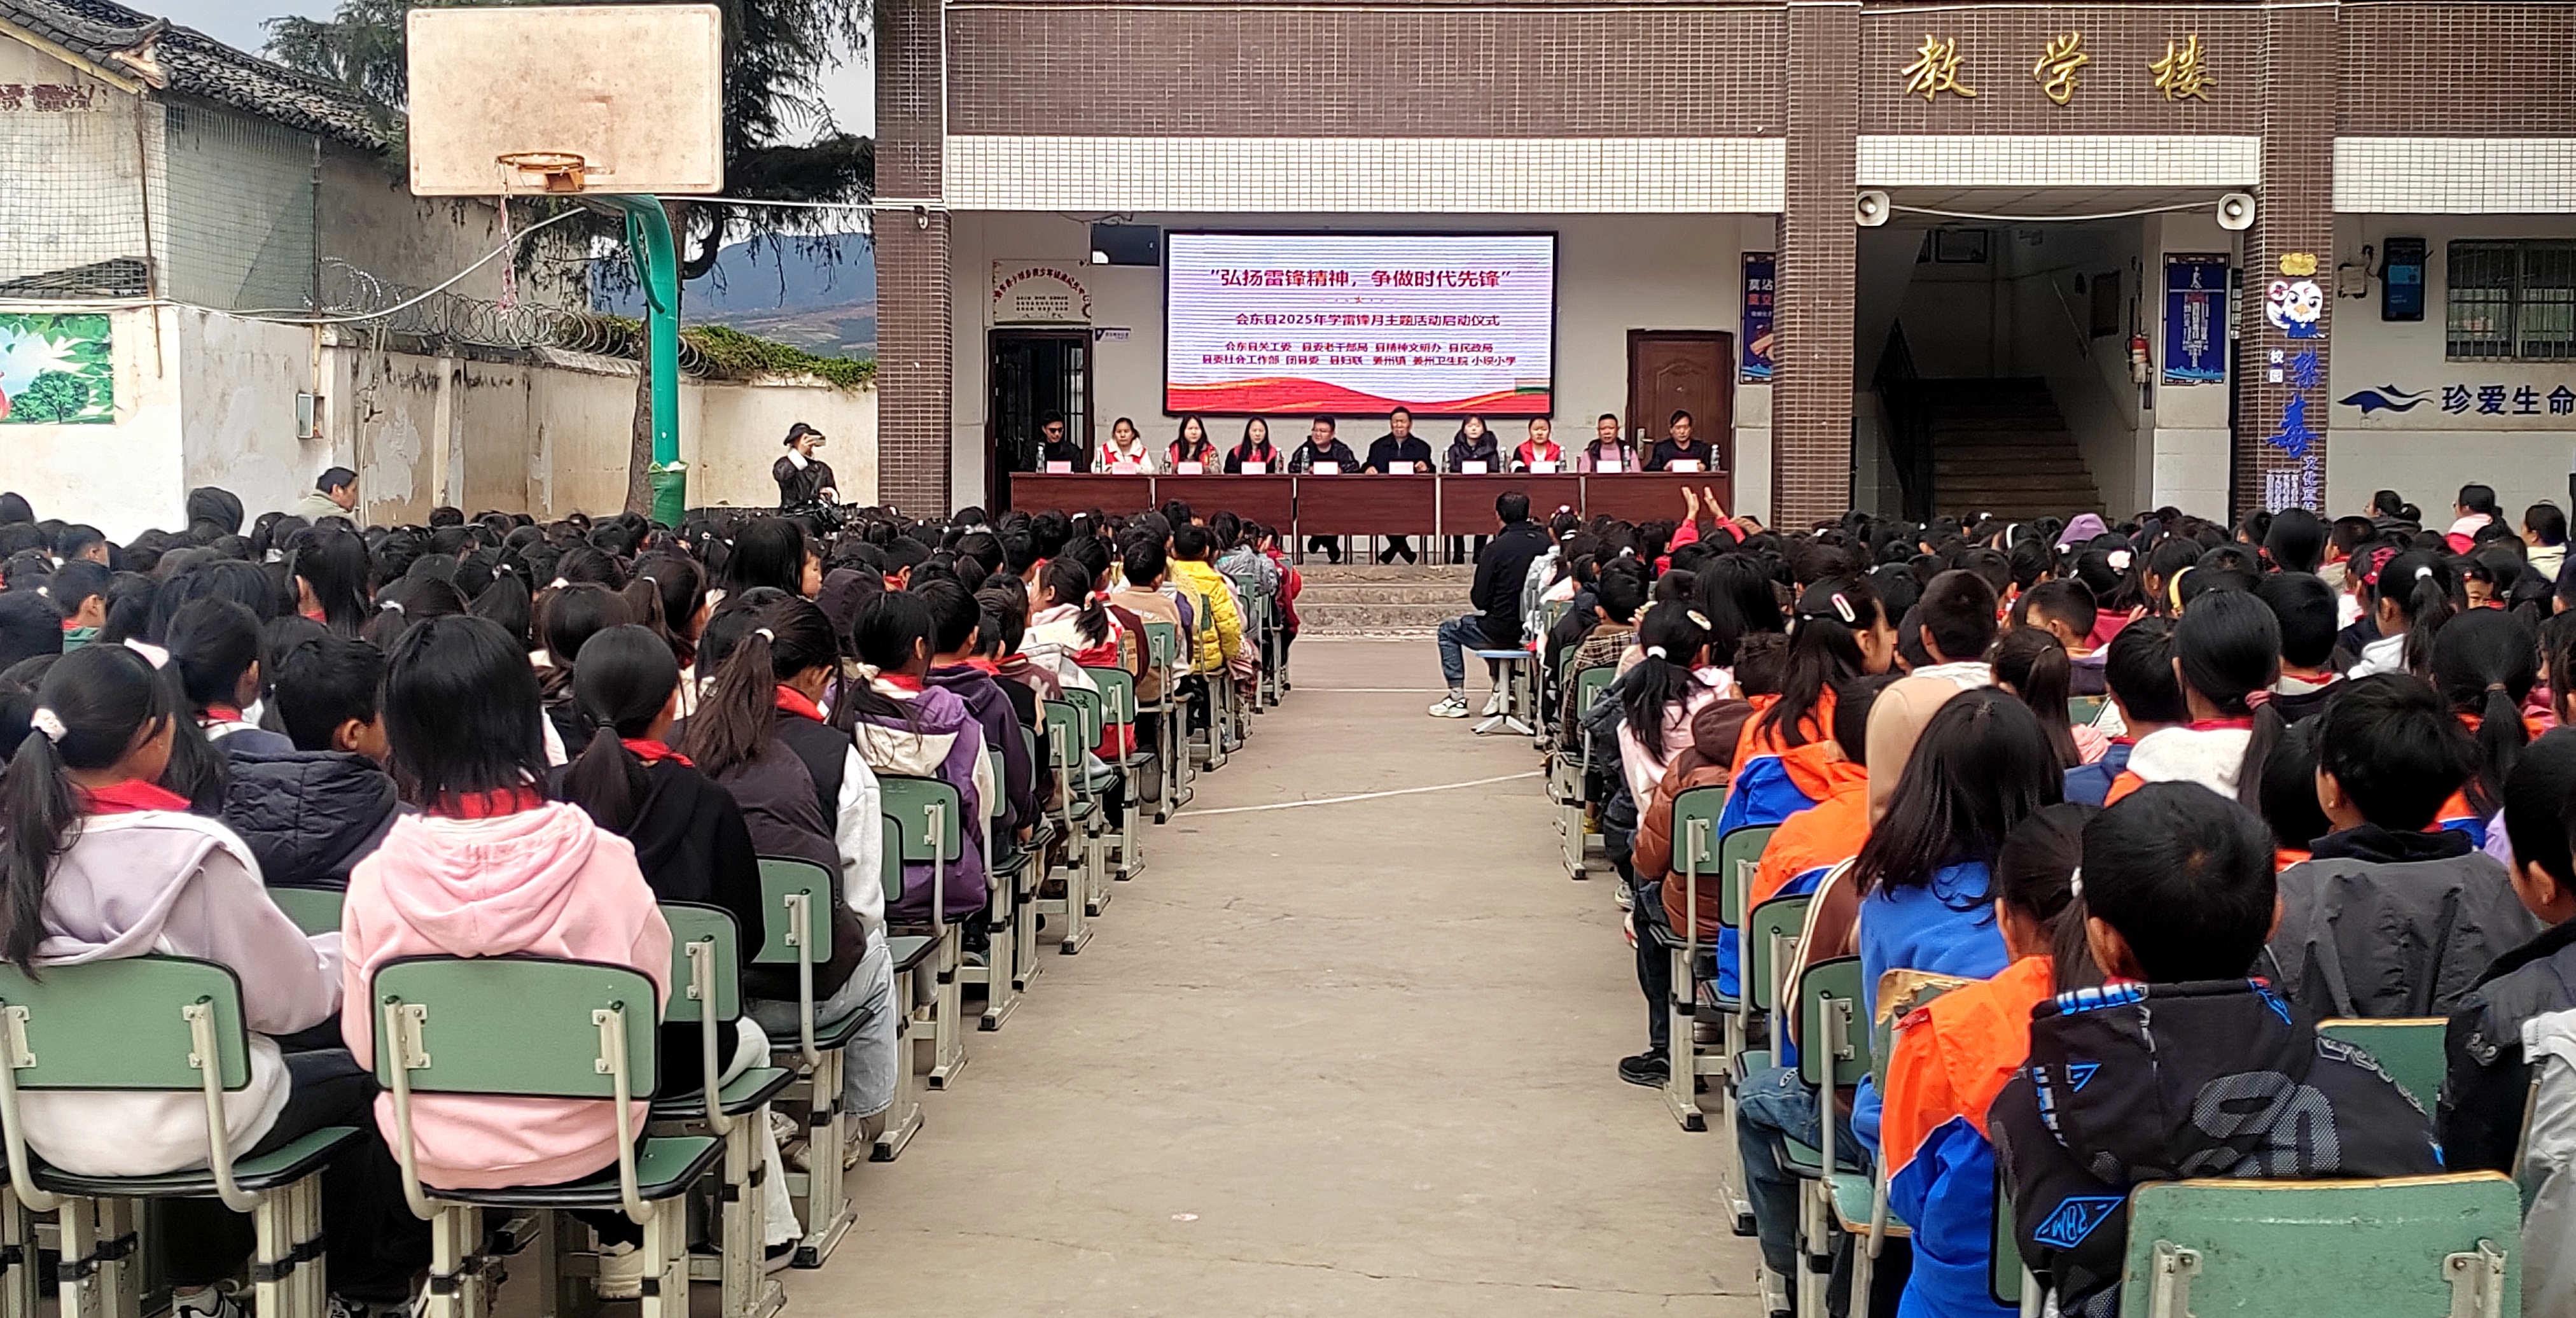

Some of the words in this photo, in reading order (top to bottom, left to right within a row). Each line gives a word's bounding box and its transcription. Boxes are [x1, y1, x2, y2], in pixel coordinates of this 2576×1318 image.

[1902, 32, 2218, 105] 教学楼
[1236, 313, 1500, 326] 会东县2025年学雷锋月主题活动启动仪式
[2442, 384, 2576, 416] 珍爱生命
